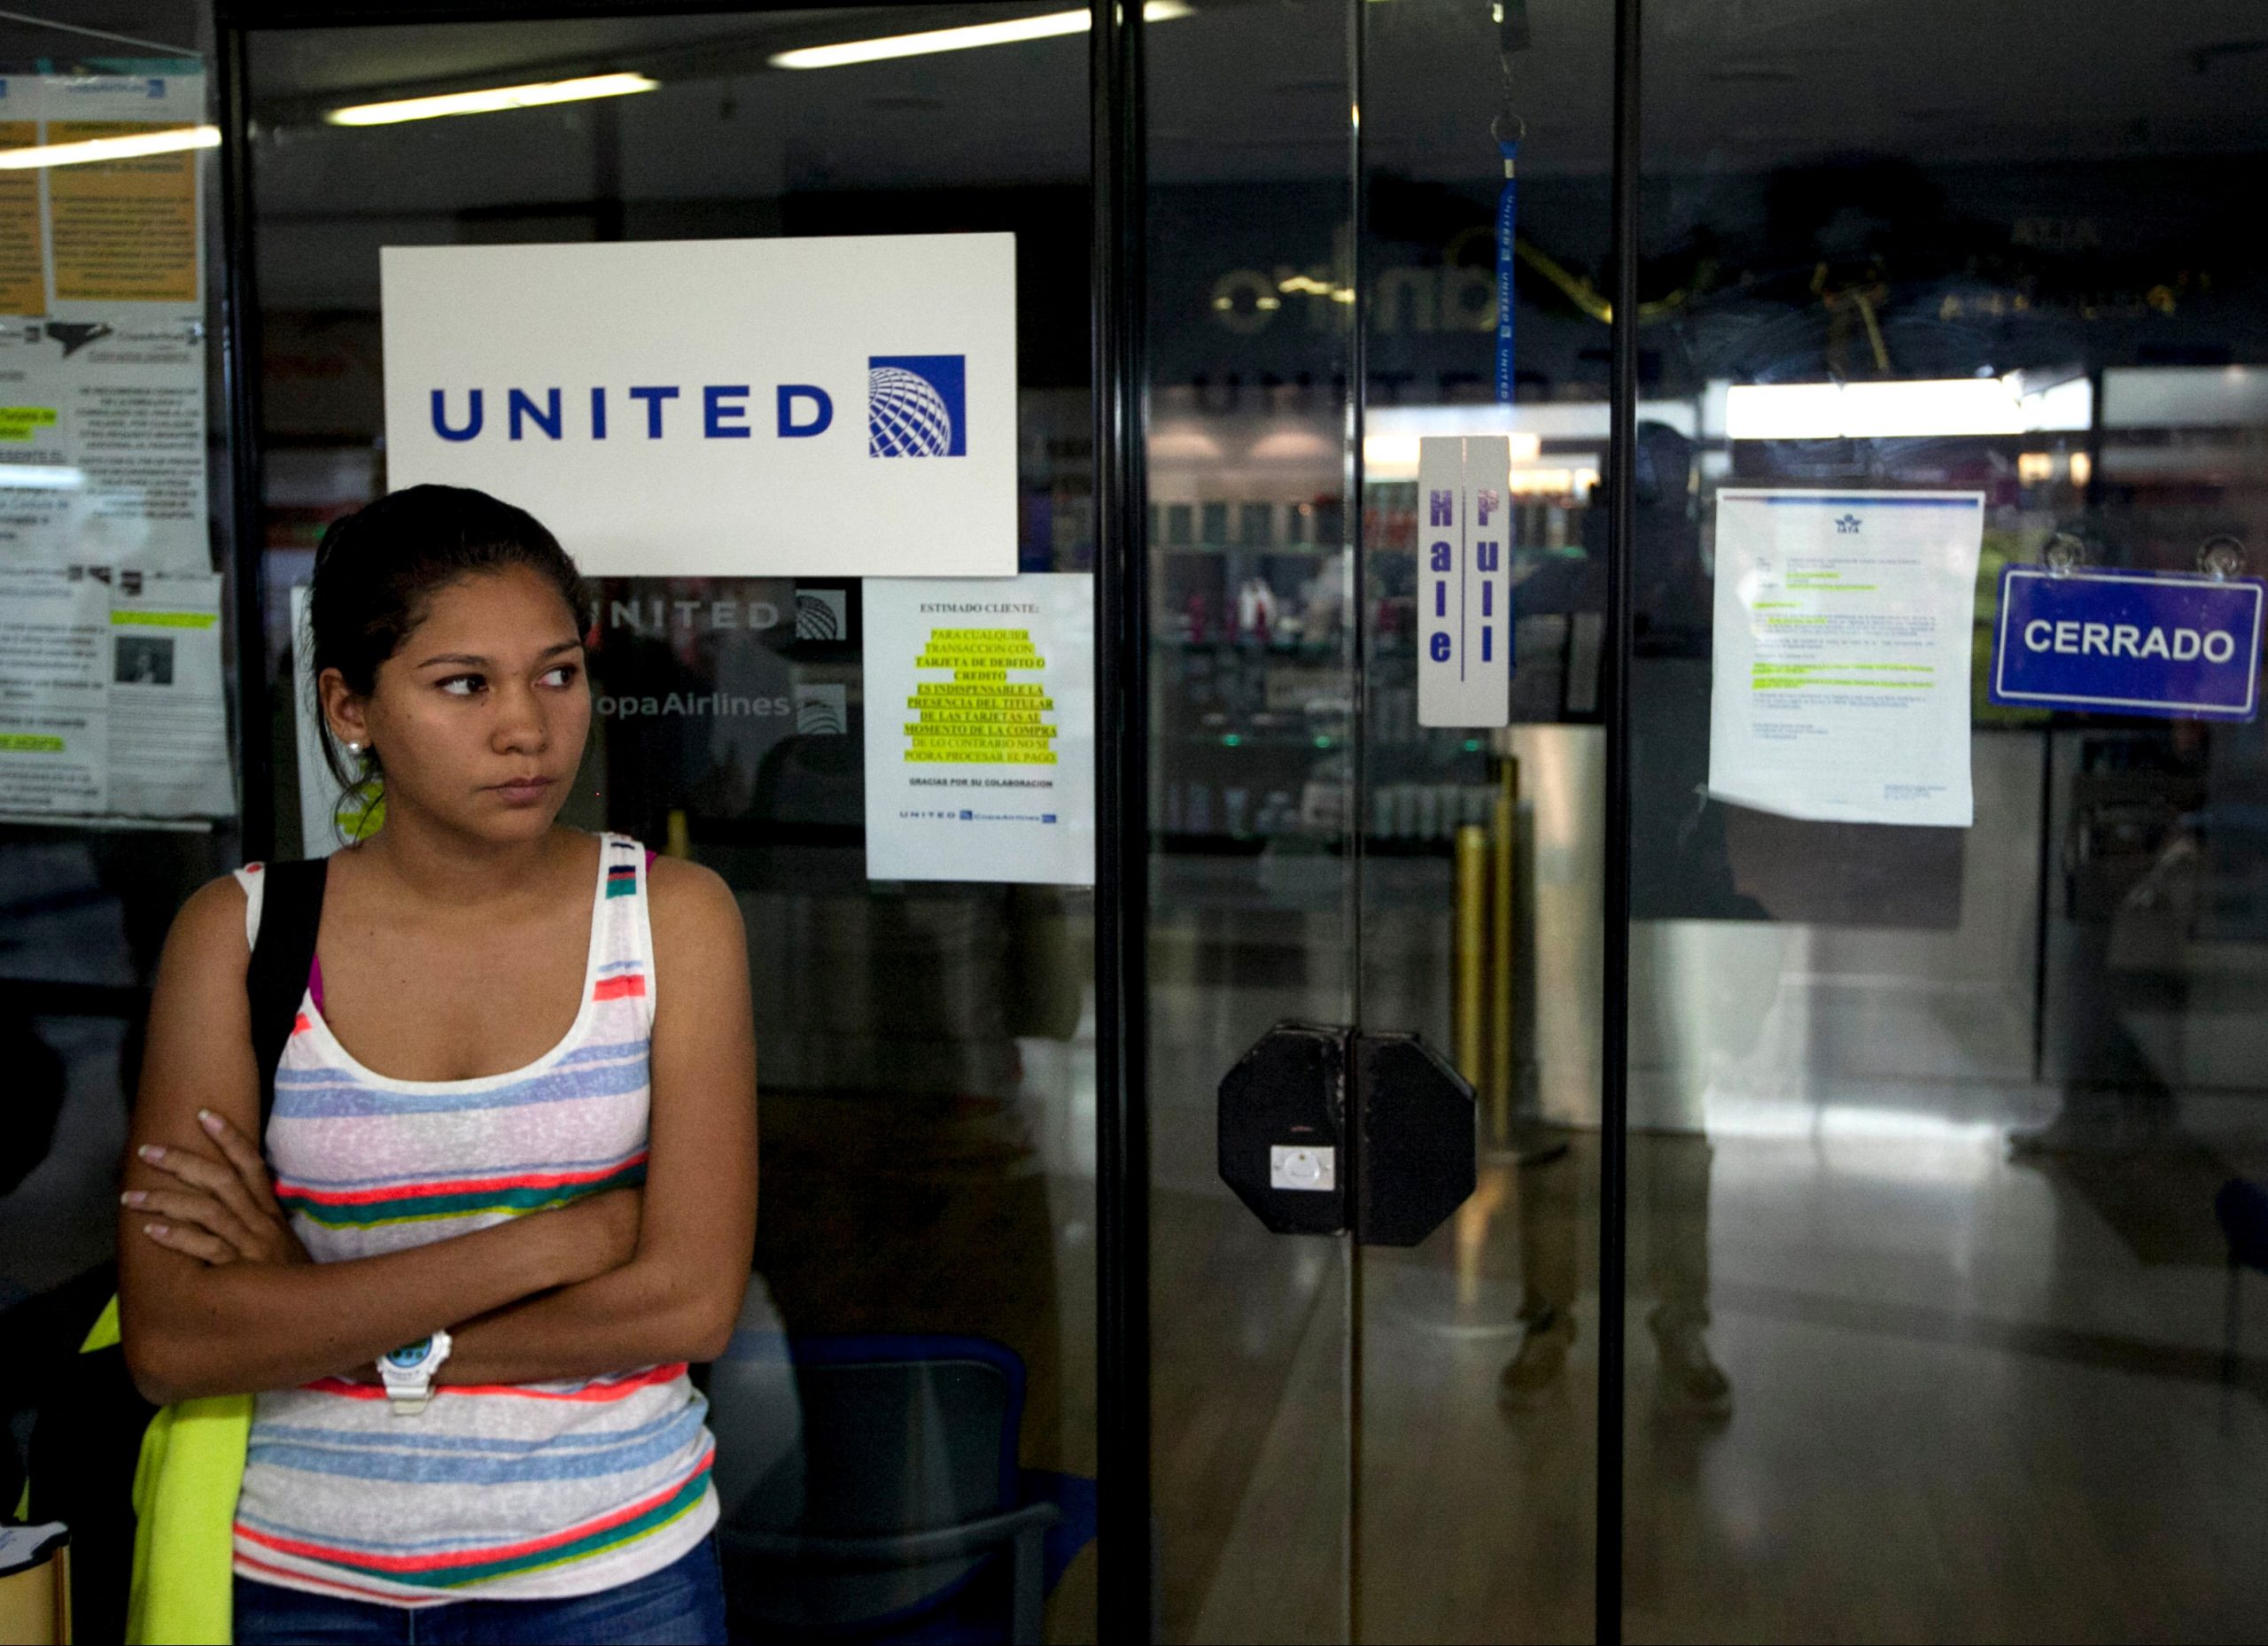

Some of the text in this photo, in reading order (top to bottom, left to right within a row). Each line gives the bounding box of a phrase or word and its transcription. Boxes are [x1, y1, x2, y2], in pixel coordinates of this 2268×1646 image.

[1501, 272, 1511, 322] UNITED
[1500, 349, 1510, 399] UNITED
[430, 384, 835, 443] UNITED
[1429, 489, 1454, 664] Hale
[1476, 489, 1501, 663] Pull
[920, 603, 1040, 614] ESTIMADO CLIENTE:
[931, 630, 1029, 641] PARA CUALQUIER
[2023, 618, 2236, 664] CERRADO
[925, 643, 1033, 654] TRANSACCION CON
[916, 657, 1045, 668] TARJETA DE DEBITO O
[953, 671, 1007, 681] CREDITO
[918, 685, 1044, 696] ES INDISPENSABLE LA
[596, 691, 791, 720] opaAirlines
[907, 698, 1054, 710] PRESENCIA DEL TITULAR
[920, 710, 1041, 723] DE LAS TARJETAS AL
[904, 724, 1058, 737] MOMENTO DE LA COMPRA
[913, 738, 1050, 749] DE LO CONTRARIO NO SE
[945, 752, 1005, 762] PROCESAR
[1006, 752, 1021, 763] EL
[909, 777, 948, 786] GRACIAS
[970, 778, 983, 787] SU
[984, 778, 1053, 788] COLABORACION
